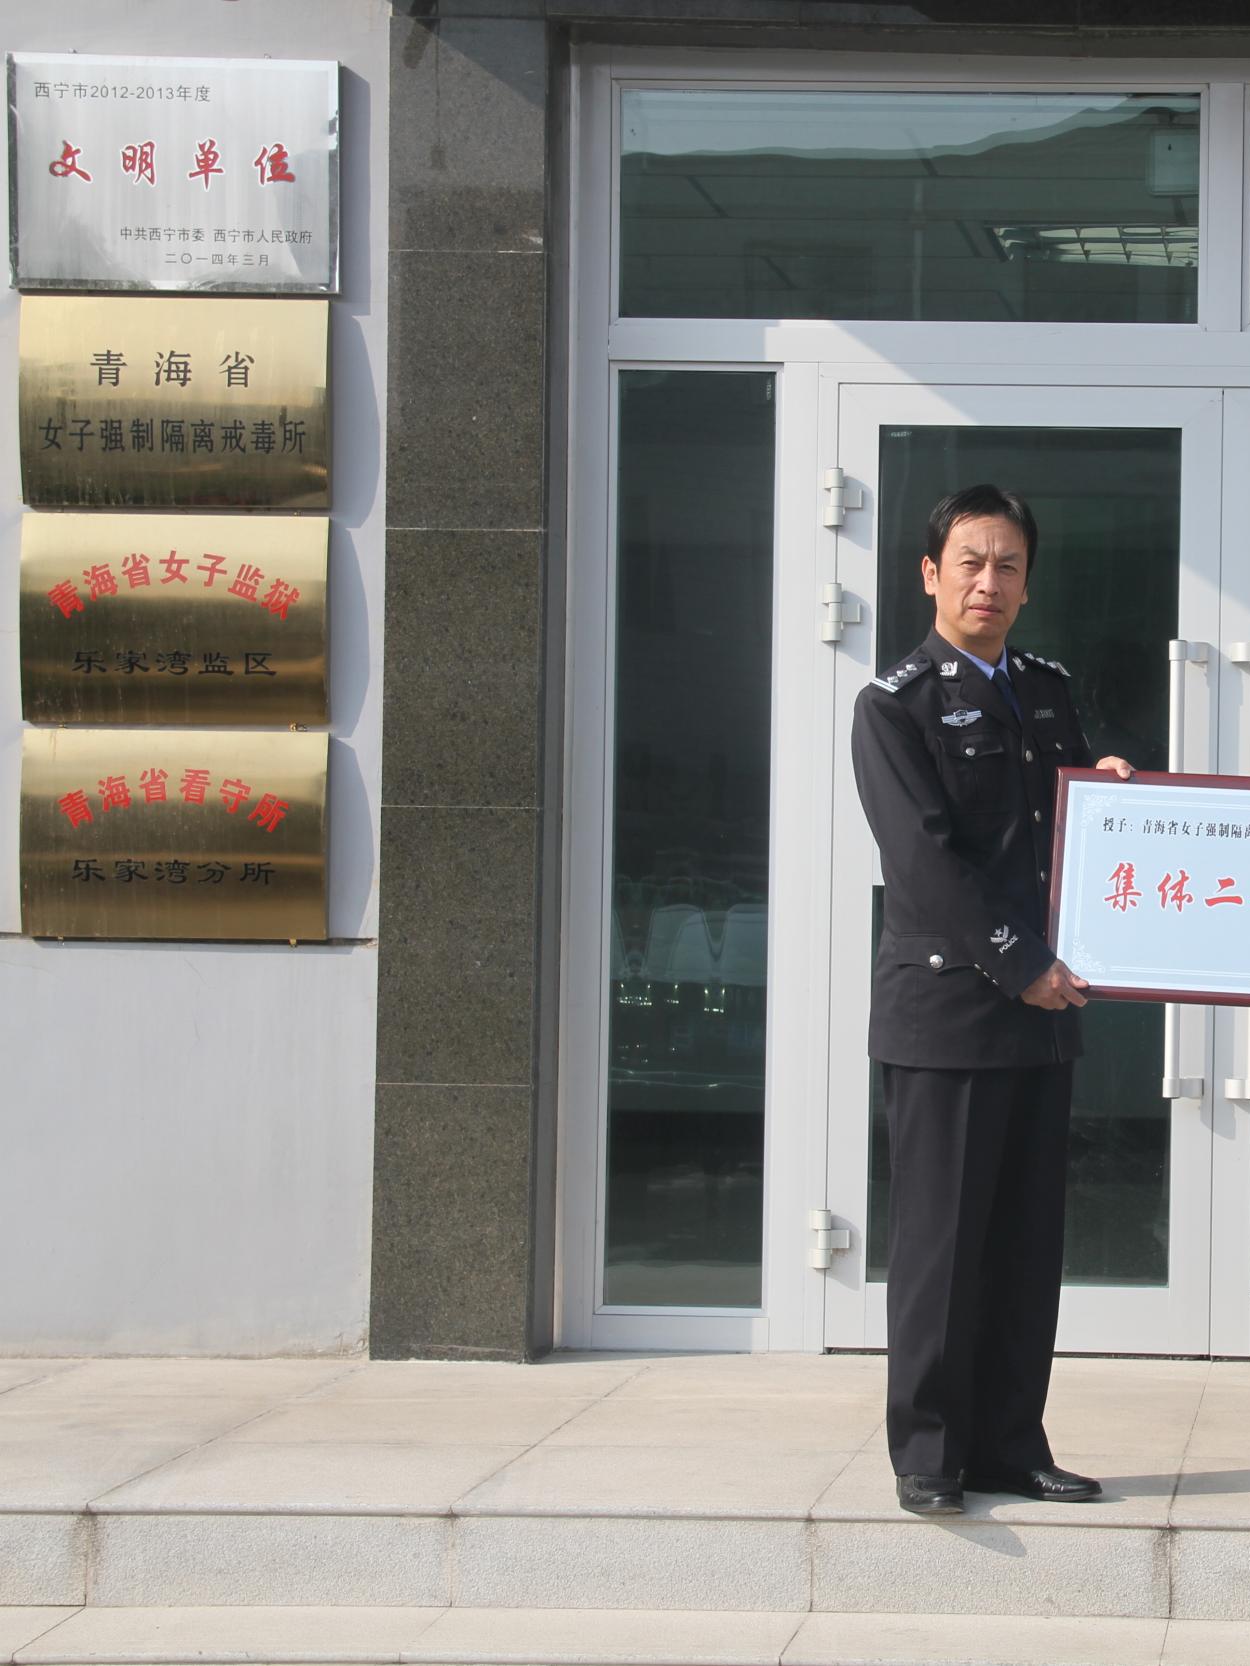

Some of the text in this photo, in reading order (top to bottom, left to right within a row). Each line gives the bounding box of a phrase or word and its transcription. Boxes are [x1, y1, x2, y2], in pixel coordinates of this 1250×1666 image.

[34, 81, 211, 103] 西宁市2012-2013年度
[49, 139, 296, 190] 文明单位
[120, 226, 313, 245] 中共西宁市委 西宁市人民政府
[90, 349, 255, 389] 青海省
[38, 416, 307, 455] 女子强制隔离戒毒所
[47, 549, 300, 621] 青海省女子监狱
[71, 650, 277, 677] 乐家湾监区
[57, 767, 289, 833] 青海省看守所
[71, 858, 276, 885] 乐家湾分所
